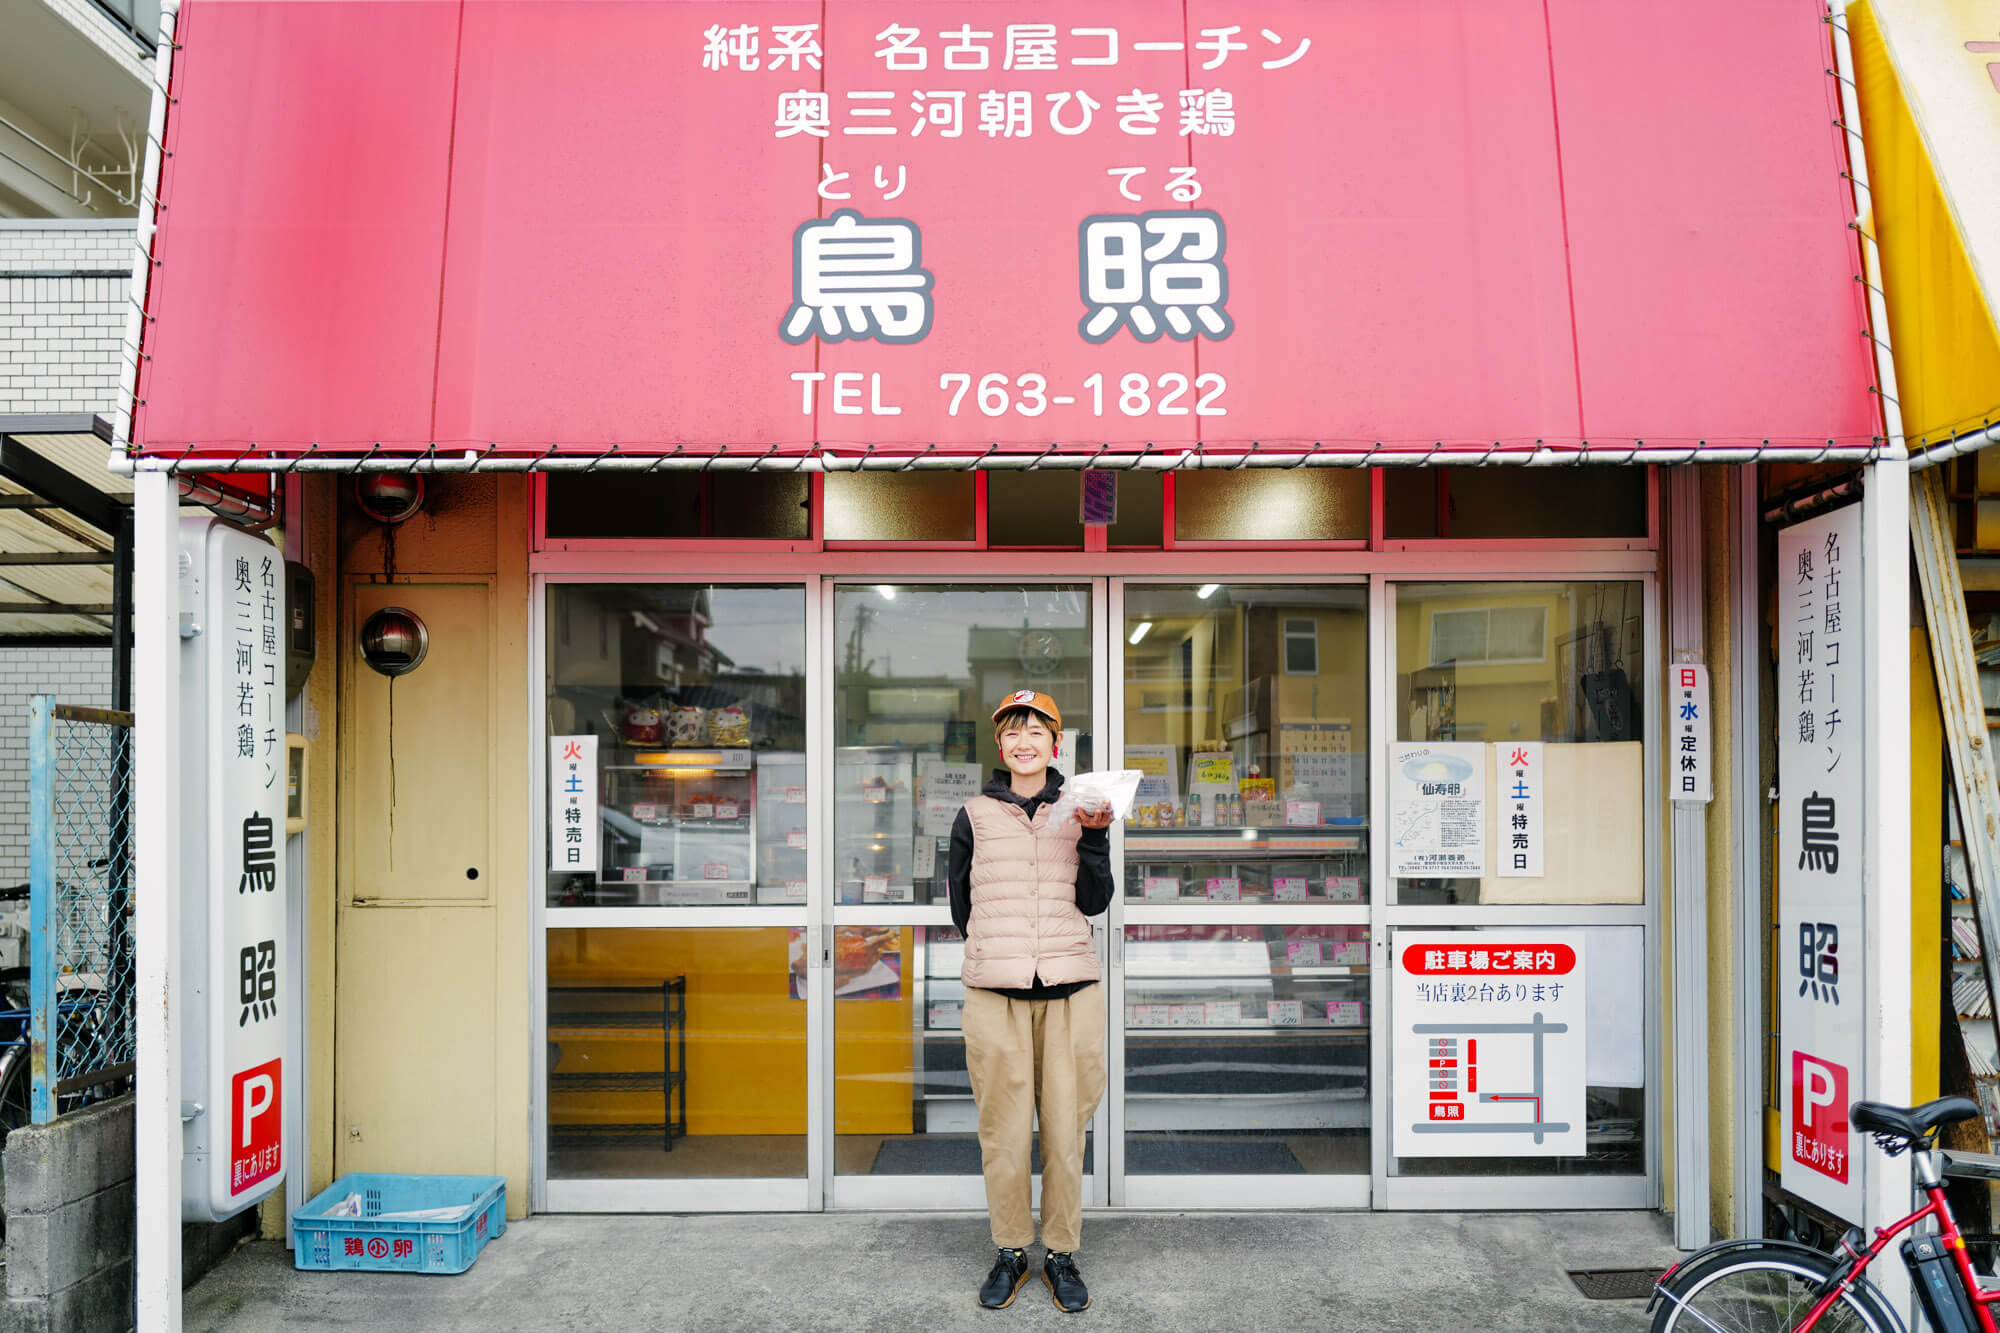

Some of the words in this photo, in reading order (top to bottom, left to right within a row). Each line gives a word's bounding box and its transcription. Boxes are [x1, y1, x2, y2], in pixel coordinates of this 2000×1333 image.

[702, 22, 824, 72] 純系
[874, 22, 1311, 71] 名古屋コーチン
[774, 88, 1236, 138] 奥三河朝ひき鶏
[790, 371, 902, 416] TEL
[939, 371, 1228, 417] 763-1822
[235, 555, 254, 760] 奥三河若鶏
[1797, 548, 1815, 745] 奥三河若鶏
[1823, 531, 1842, 774] 名古屋コーチン
[260, 555, 277, 790] 名古屋コーチン
[1424, 950, 1556, 970] 駐車場ご案内
[1415, 982, 1565, 1003] 当店裏2台あります
[1439, 1059, 1446, 1068] P
[242, 1073, 274, 1148] P
[1433, 1104, 1460, 1118] 鳥照
[1803, 1059, 1836, 1128] P
[1795, 1130, 1845, 1175] 裏にあります
